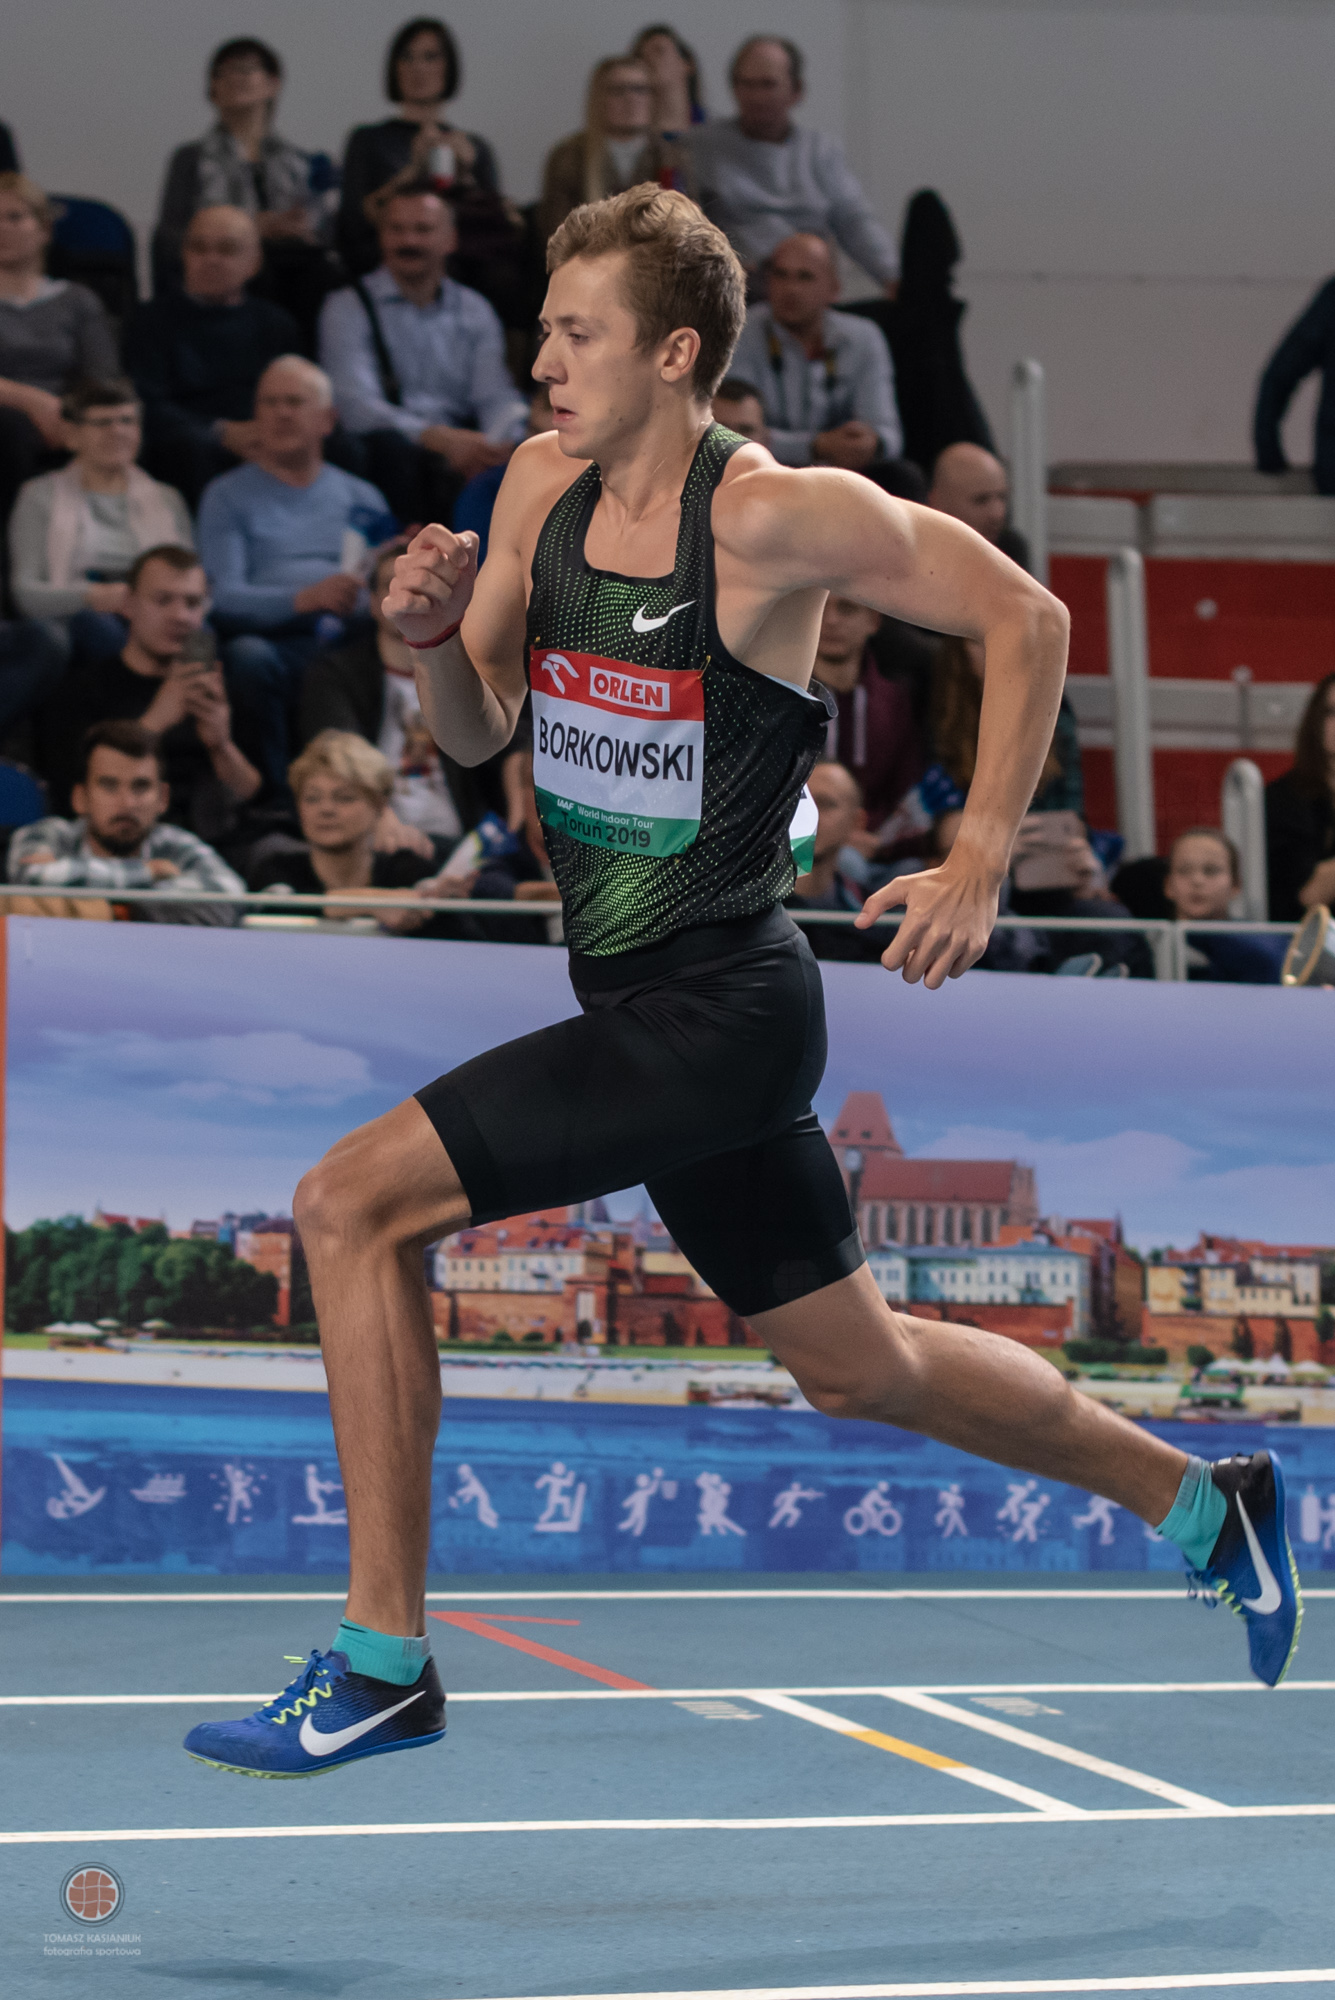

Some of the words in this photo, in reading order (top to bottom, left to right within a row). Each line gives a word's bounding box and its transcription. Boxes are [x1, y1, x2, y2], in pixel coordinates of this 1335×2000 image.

[593, 672, 664, 708] ORLEN
[539, 715, 694, 782] BORKOWSKI
[556, 798, 575, 811] IAAF
[577, 805, 600, 820] World
[601, 812, 630, 826] Indoor
[632, 817, 655, 829] Tour
[561, 810, 602, 839] Toruń
[605, 824, 651, 848] 2019
